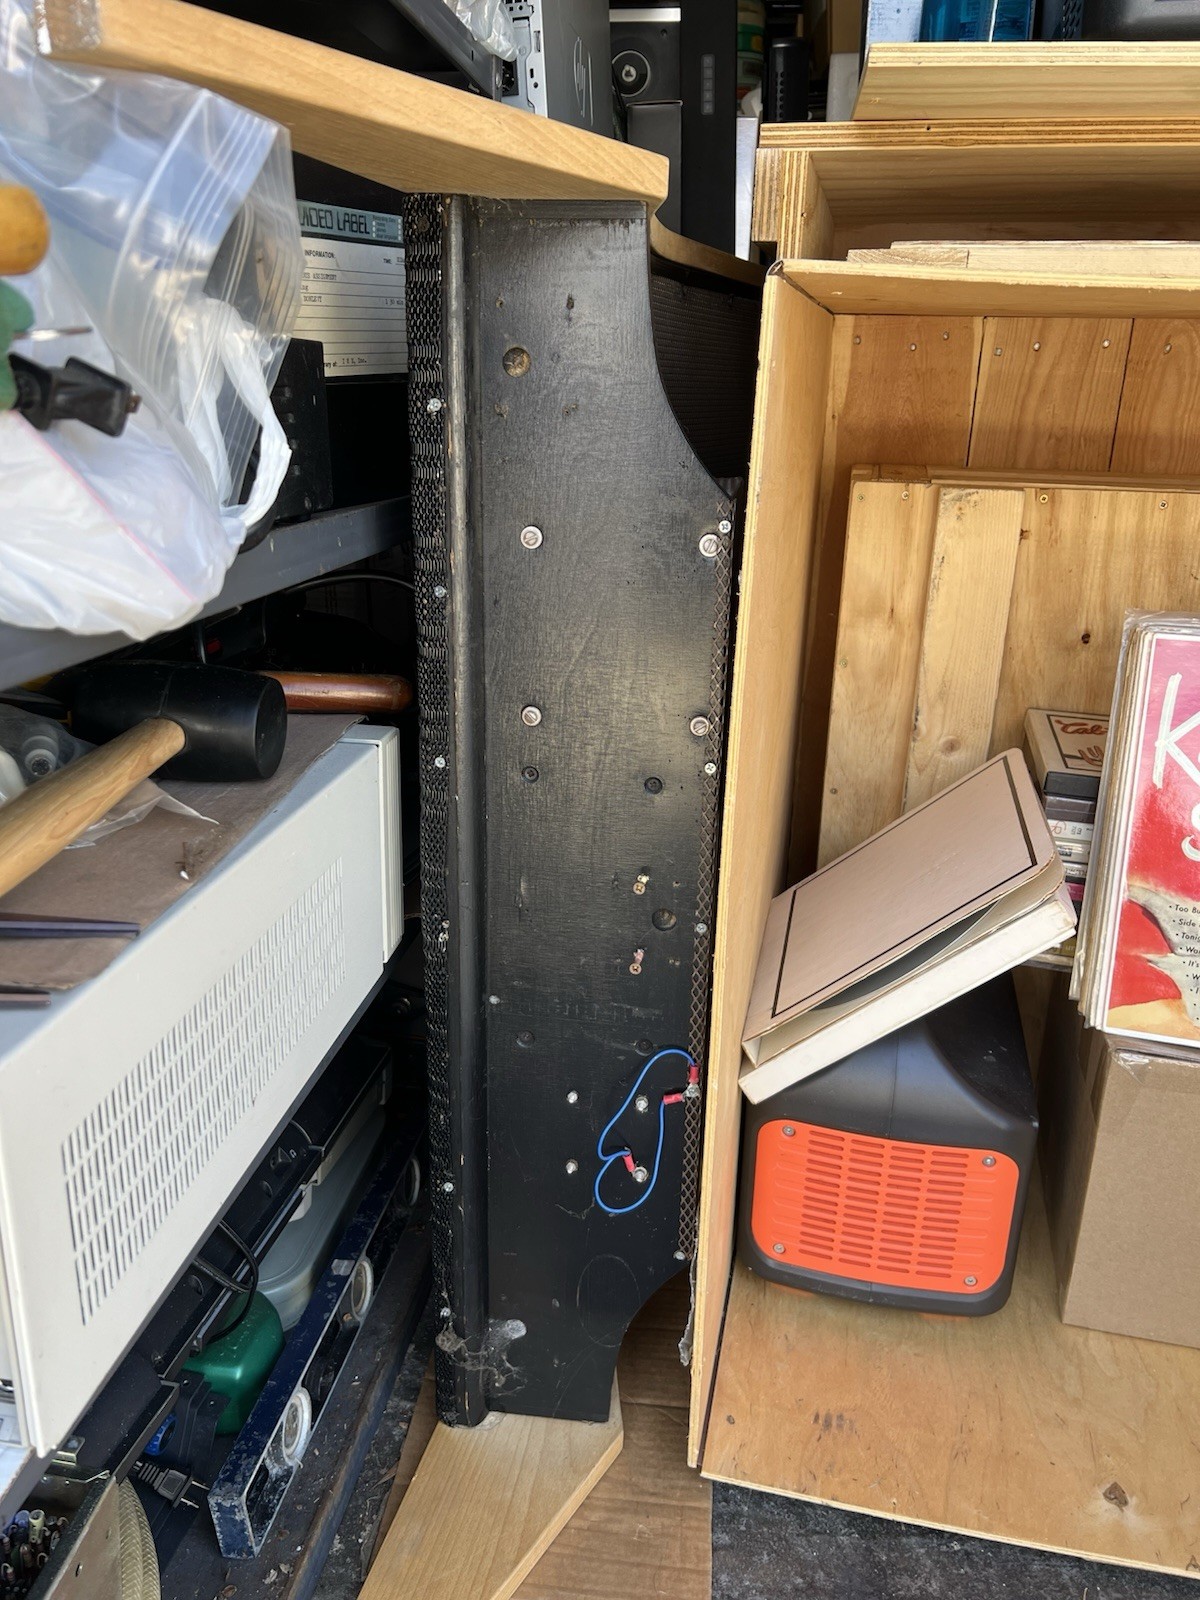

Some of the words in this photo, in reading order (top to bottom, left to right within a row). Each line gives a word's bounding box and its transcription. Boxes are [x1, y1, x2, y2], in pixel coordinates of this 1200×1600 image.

[337, 210, 370, 235] LABEL
[1175, 904, 1189, 913] Too
[1178, 918, 1196, 927] Side
